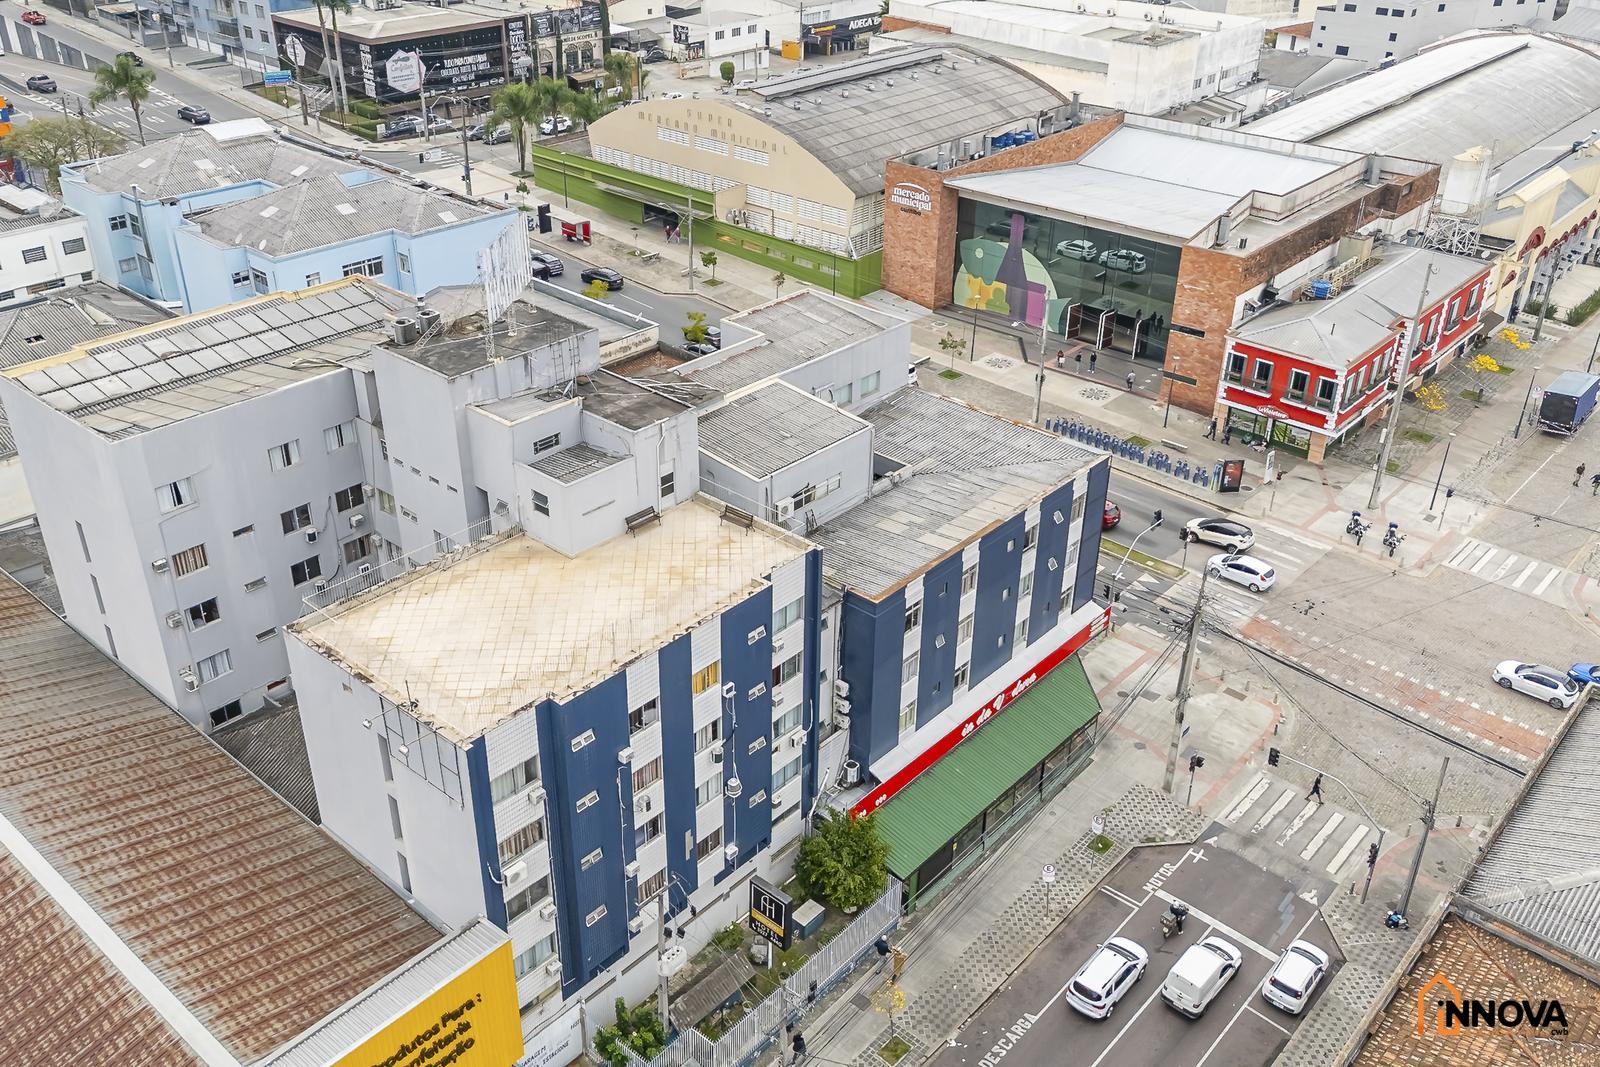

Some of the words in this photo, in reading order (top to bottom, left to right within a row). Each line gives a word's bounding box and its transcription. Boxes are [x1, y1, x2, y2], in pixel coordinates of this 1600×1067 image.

[849, 18, 872, 30] ADEGA
[891, 195, 932, 211] municipal
[893, 187, 930, 202] mercado
[1142, 862, 1176, 894] MOTOS
[755, 920, 779, 940] HOTEL
[441, 999, 475, 1028] Para
[978, 1013, 1037, 1067] DESCARGA
